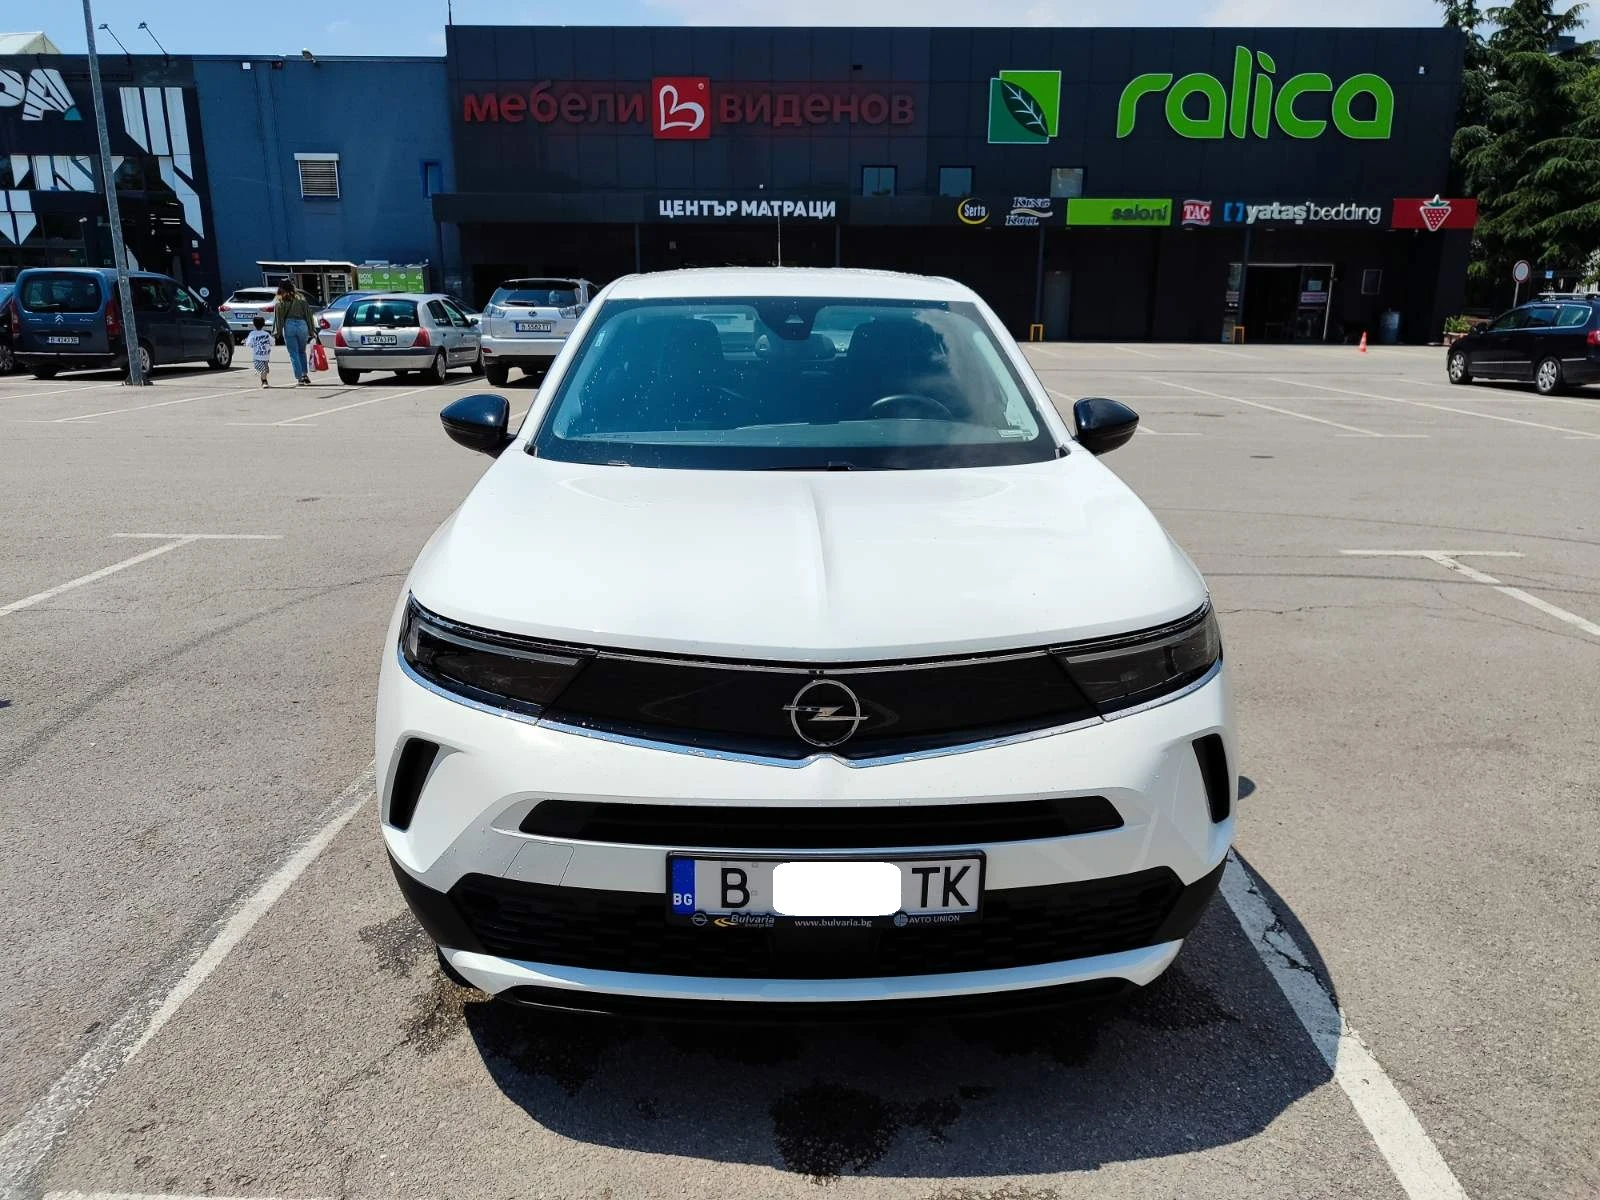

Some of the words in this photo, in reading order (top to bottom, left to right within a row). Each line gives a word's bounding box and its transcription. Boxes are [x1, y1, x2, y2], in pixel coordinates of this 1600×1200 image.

[1116, 45, 1394, 139] ralica
[463, 80, 645, 123] мебели
[719, 92, 915, 127] виденов
[658, 199, 738, 218] ЦЕНТЪР
[741, 200, 836, 219] МАТРАЦИ
[964, 203, 986, 217] Serta
[1183, 205, 1211, 220] TAC
[1309, 202, 1381, 224] bedding
[721, 867, 750, 908] B
[911, 865, 971, 908] TK
[672, 893, 693, 906] BG
[731, 913, 775, 924] Bulvaria
[794, 918, 872, 927] www.bulvaria.bg
[933, 914, 960, 923] UNION
